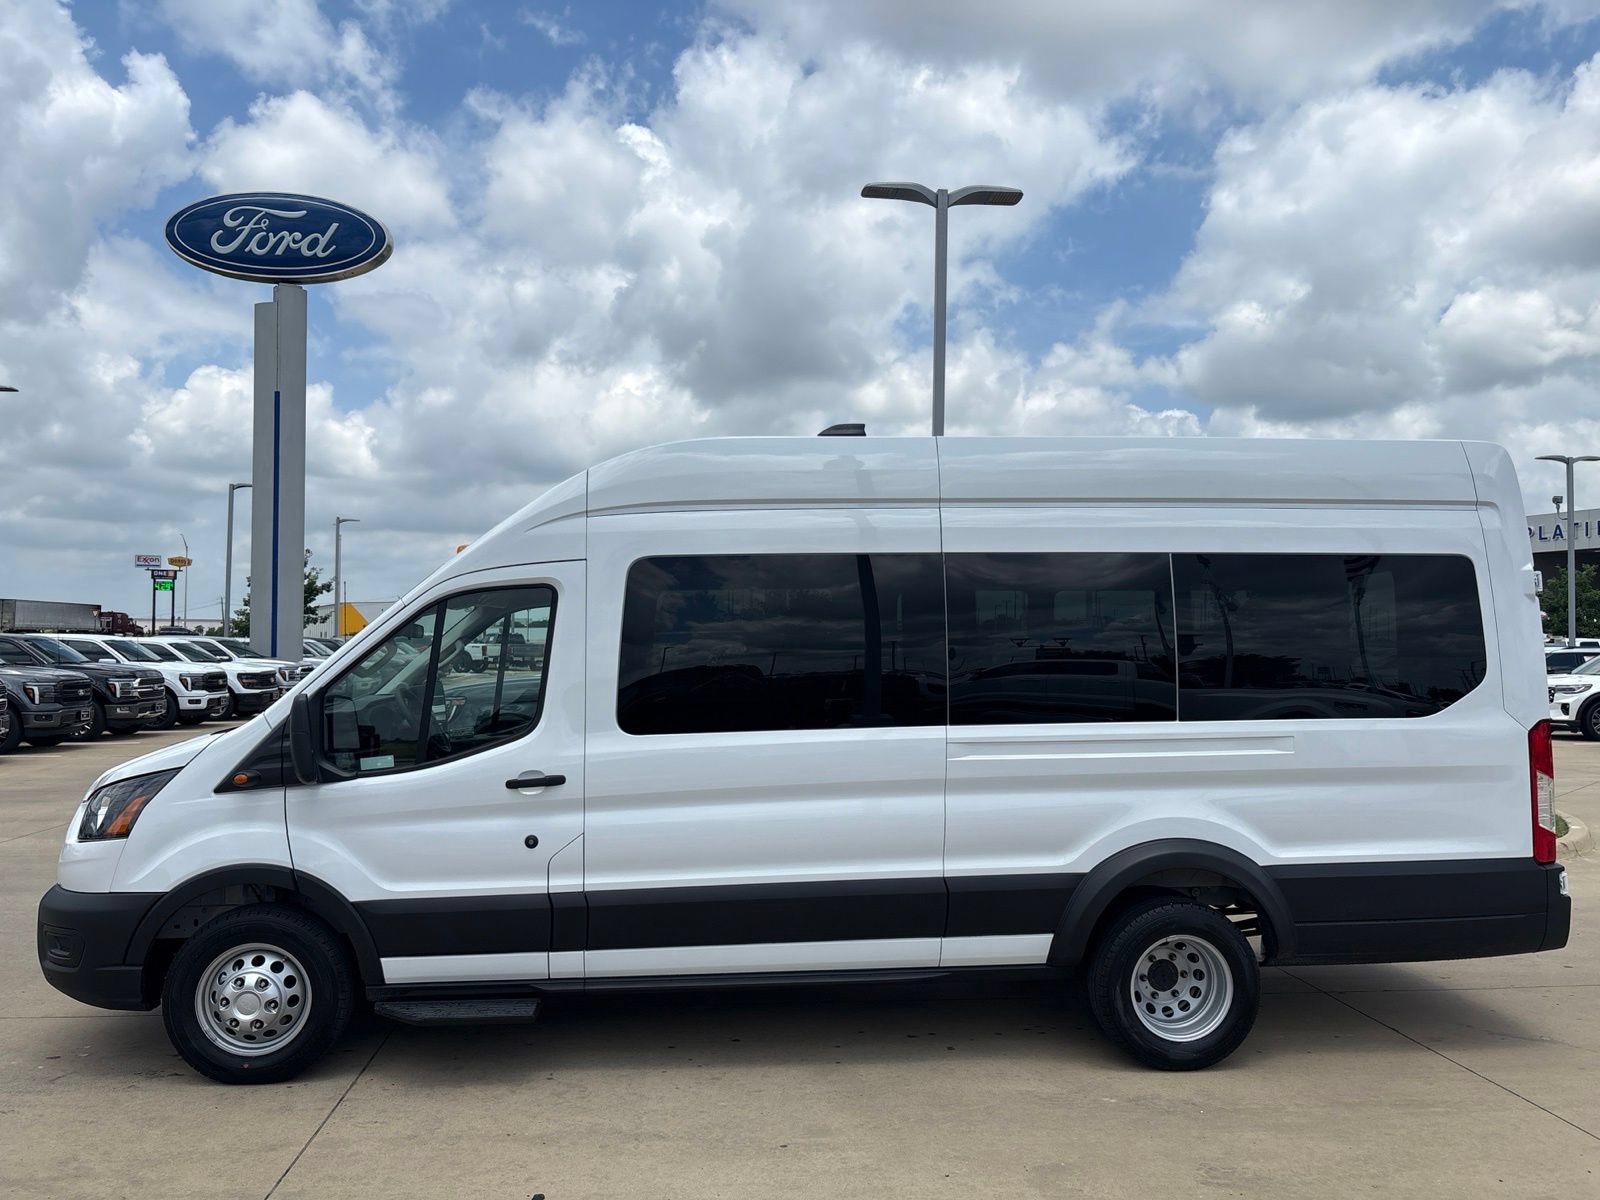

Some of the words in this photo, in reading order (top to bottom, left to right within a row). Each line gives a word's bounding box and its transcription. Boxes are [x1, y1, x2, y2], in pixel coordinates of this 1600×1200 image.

[210, 205, 340, 258] Ford
[1528, 521, 1600, 540] LAI
[137, 555, 160, 565] Exxon
